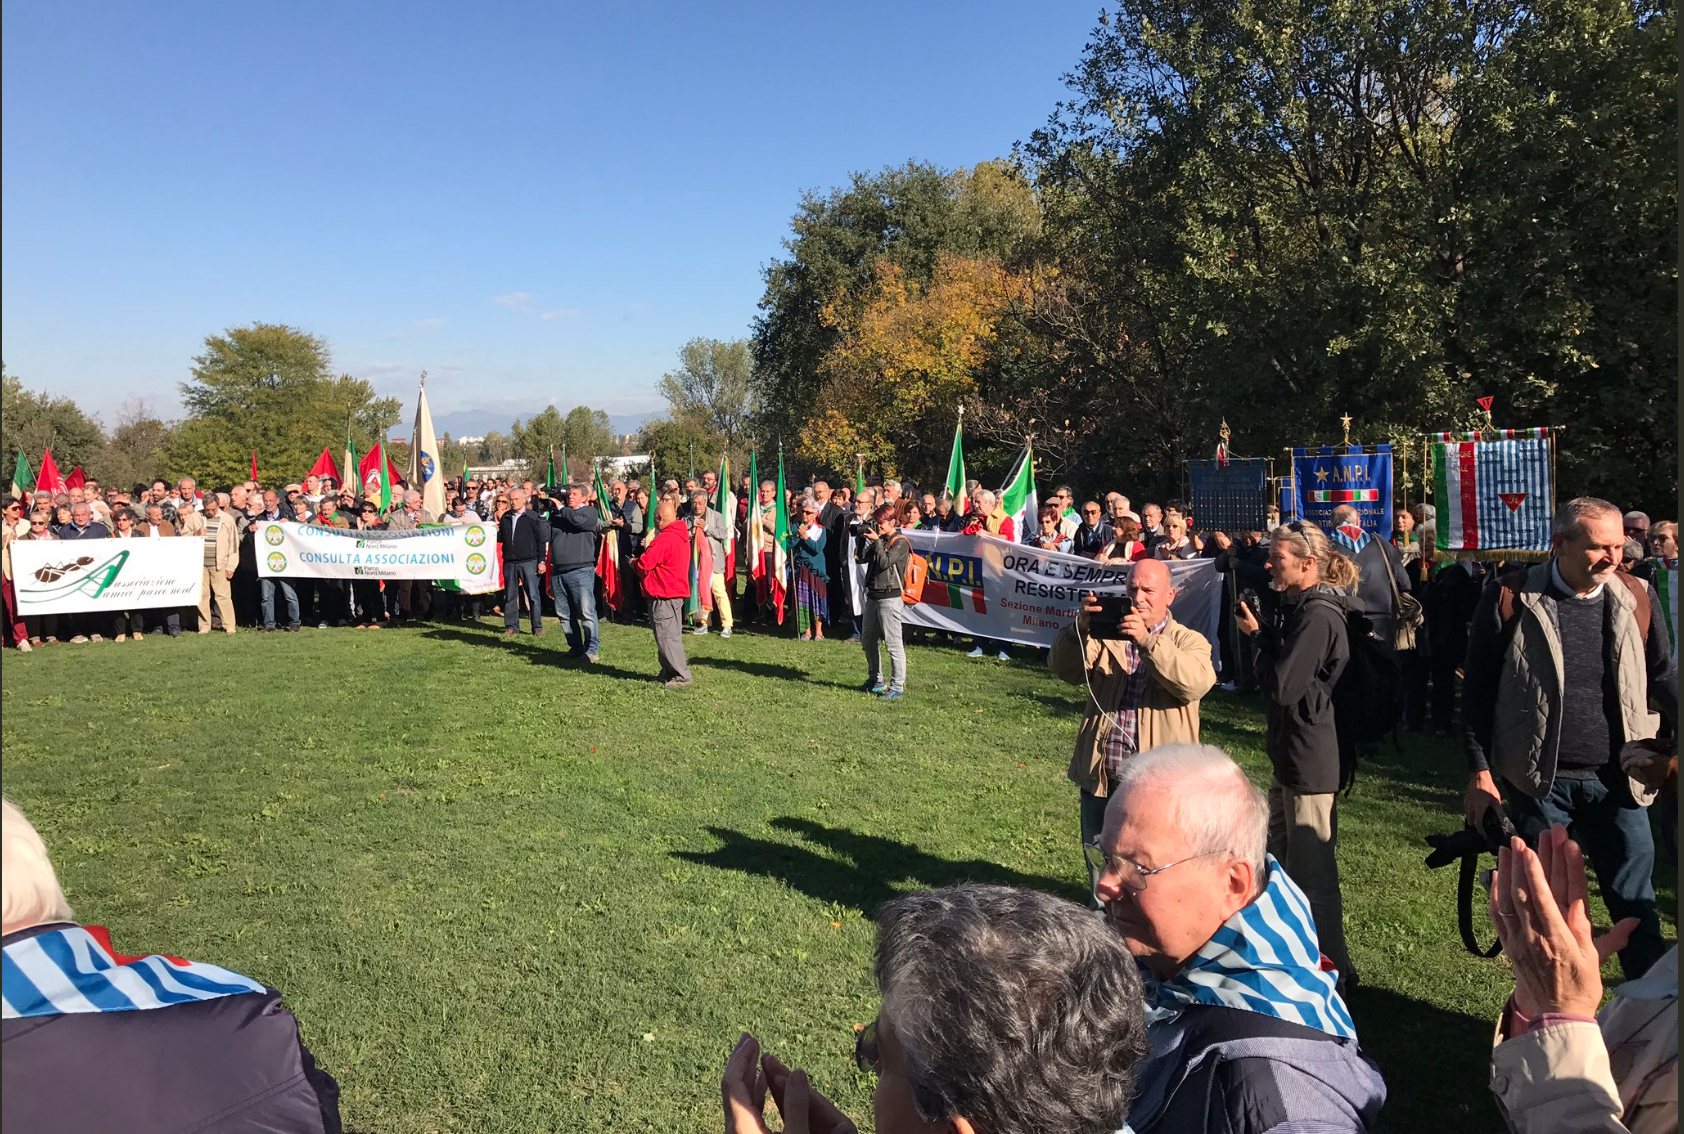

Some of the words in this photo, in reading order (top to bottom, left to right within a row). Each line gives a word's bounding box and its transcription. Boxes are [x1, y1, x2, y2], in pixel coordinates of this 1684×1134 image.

[1333, 464, 1371, 482] A.N.P.I.
[299, 552, 361, 564] CONSULTA
[365, 553, 455, 564] ASSOCIAZIONI
[925, 554, 982, 586] N.P.I.
[1003, 555, 1039, 574] ORA
[1044, 561, 1059, 576] E
[1063, 563, 1127, 585] SEMPR
[1015, 580, 1126, 602] RESISTE
[1000, 597, 1042, 613] Sezione
[1022, 615, 1060, 629] Milano
